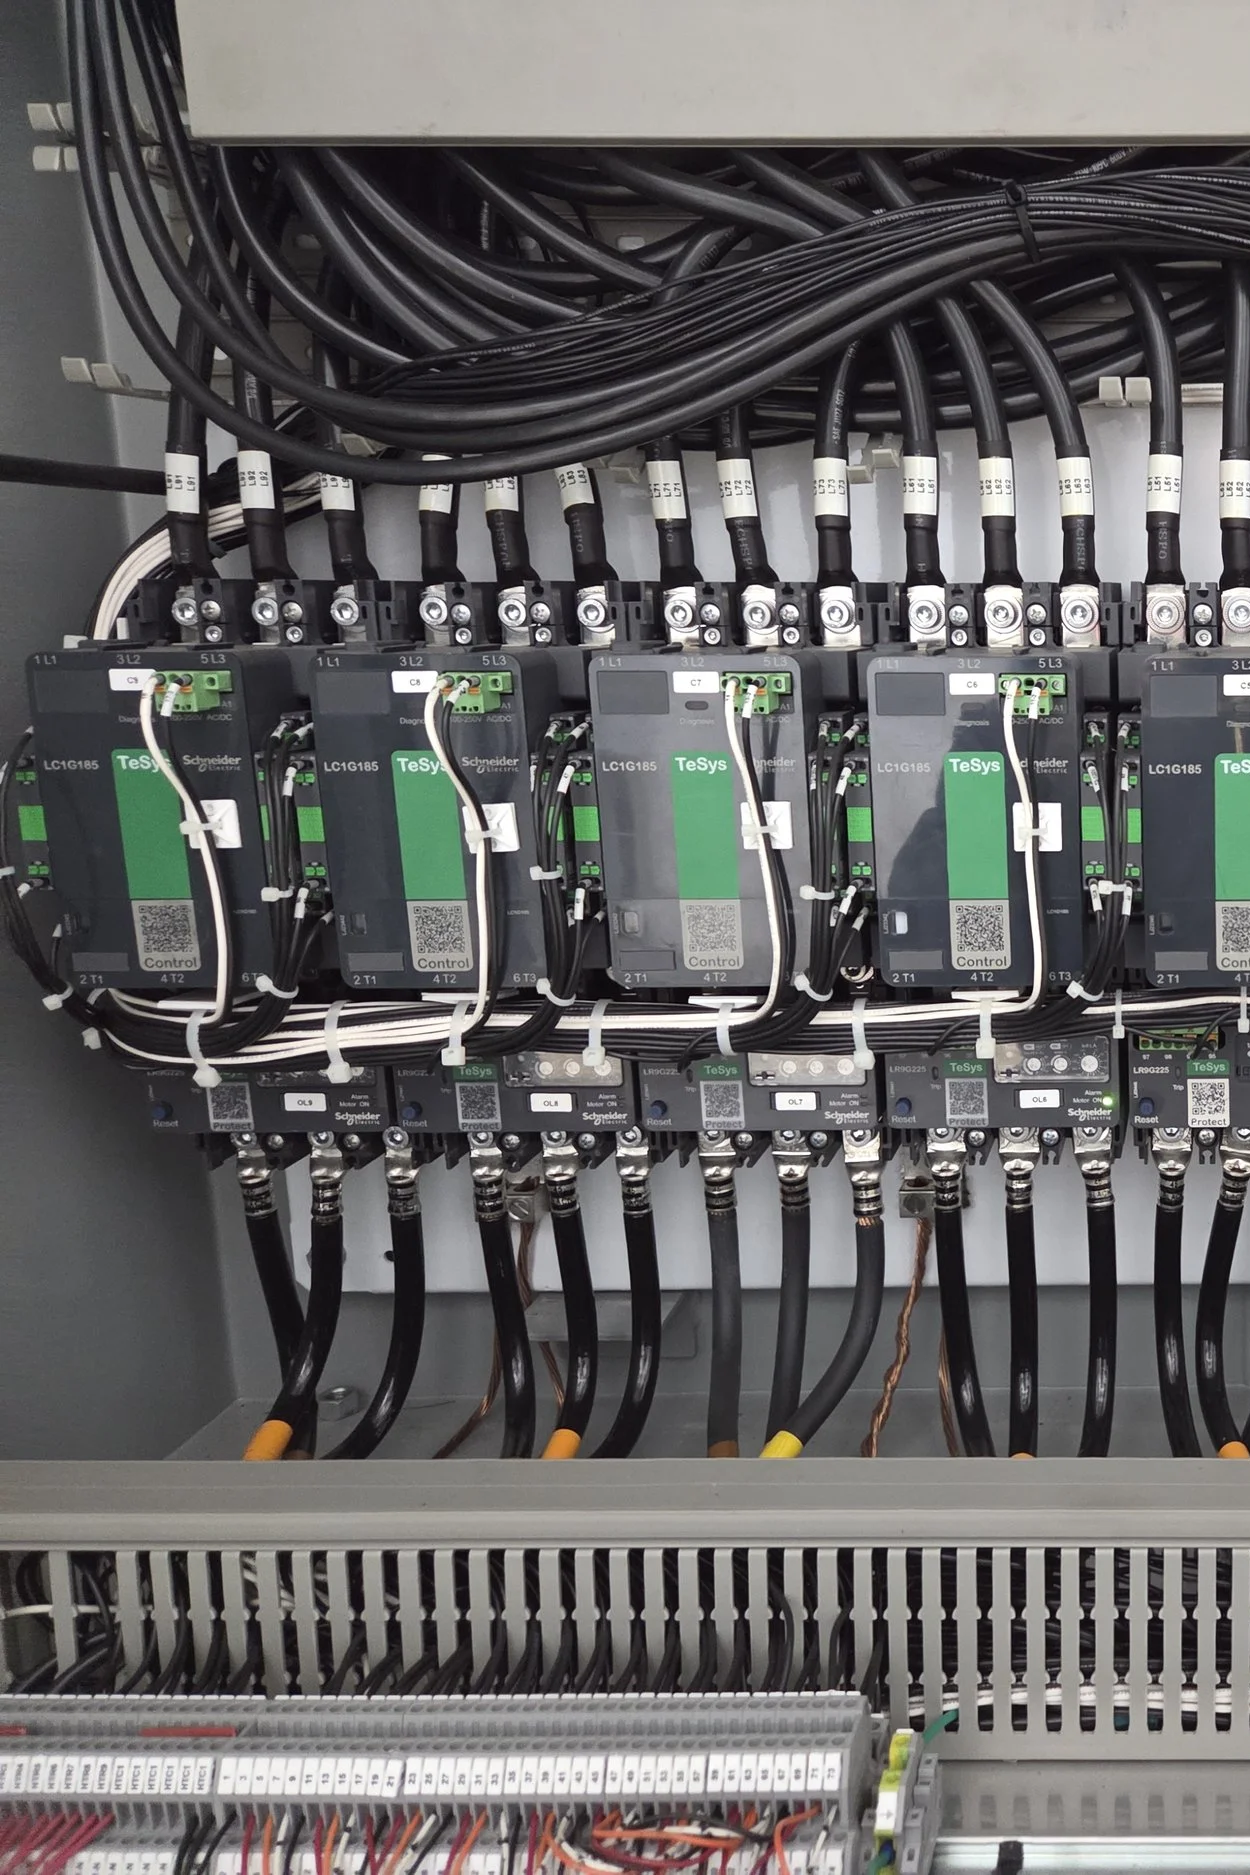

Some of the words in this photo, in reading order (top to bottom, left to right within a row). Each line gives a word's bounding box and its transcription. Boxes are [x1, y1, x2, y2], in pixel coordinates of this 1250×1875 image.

[664, 482, 672, 497] L71
[828, 478, 836, 494] L73
[1074, 478, 1082, 493] L63
[44, 760, 99, 770] LC1G185
[184, 756, 241, 766] Schneider
[462, 757, 519, 767] Schneider
[675, 757, 727, 774] TeSys
[324, 762, 378, 772] LC1G185
[602, 762, 657, 771] LC1G185
[877, 763, 931, 773] LC1G185
[949, 759, 1000, 775] TeSys
[1149, 764, 1202, 774] LC1G185
[144, 958, 197, 969] Control
[418, 958, 469, 969] Control
[689, 956, 740, 967] Control
[957, 956, 1006, 967] Control
[460, 1067, 492, 1076] TeSys
[704, 1065, 737, 1075] TeSys
[950, 1063, 983, 1072] TeSys
[1193, 1063, 1225, 1073] TeSys
[335, 1112, 380, 1120] Schneider
[583, 1112, 627, 1121] Schneider
[825, 1111, 869, 1120] Schneider
[1068, 1108, 1112, 1116] Schneider
[153, 1120, 178, 1128] Reset
[403, 1120, 427, 1128] Reset
[647, 1118, 672, 1126] Reset
[892, 1115, 916, 1123] Reset
[213, 1122, 251, 1130] Protect
